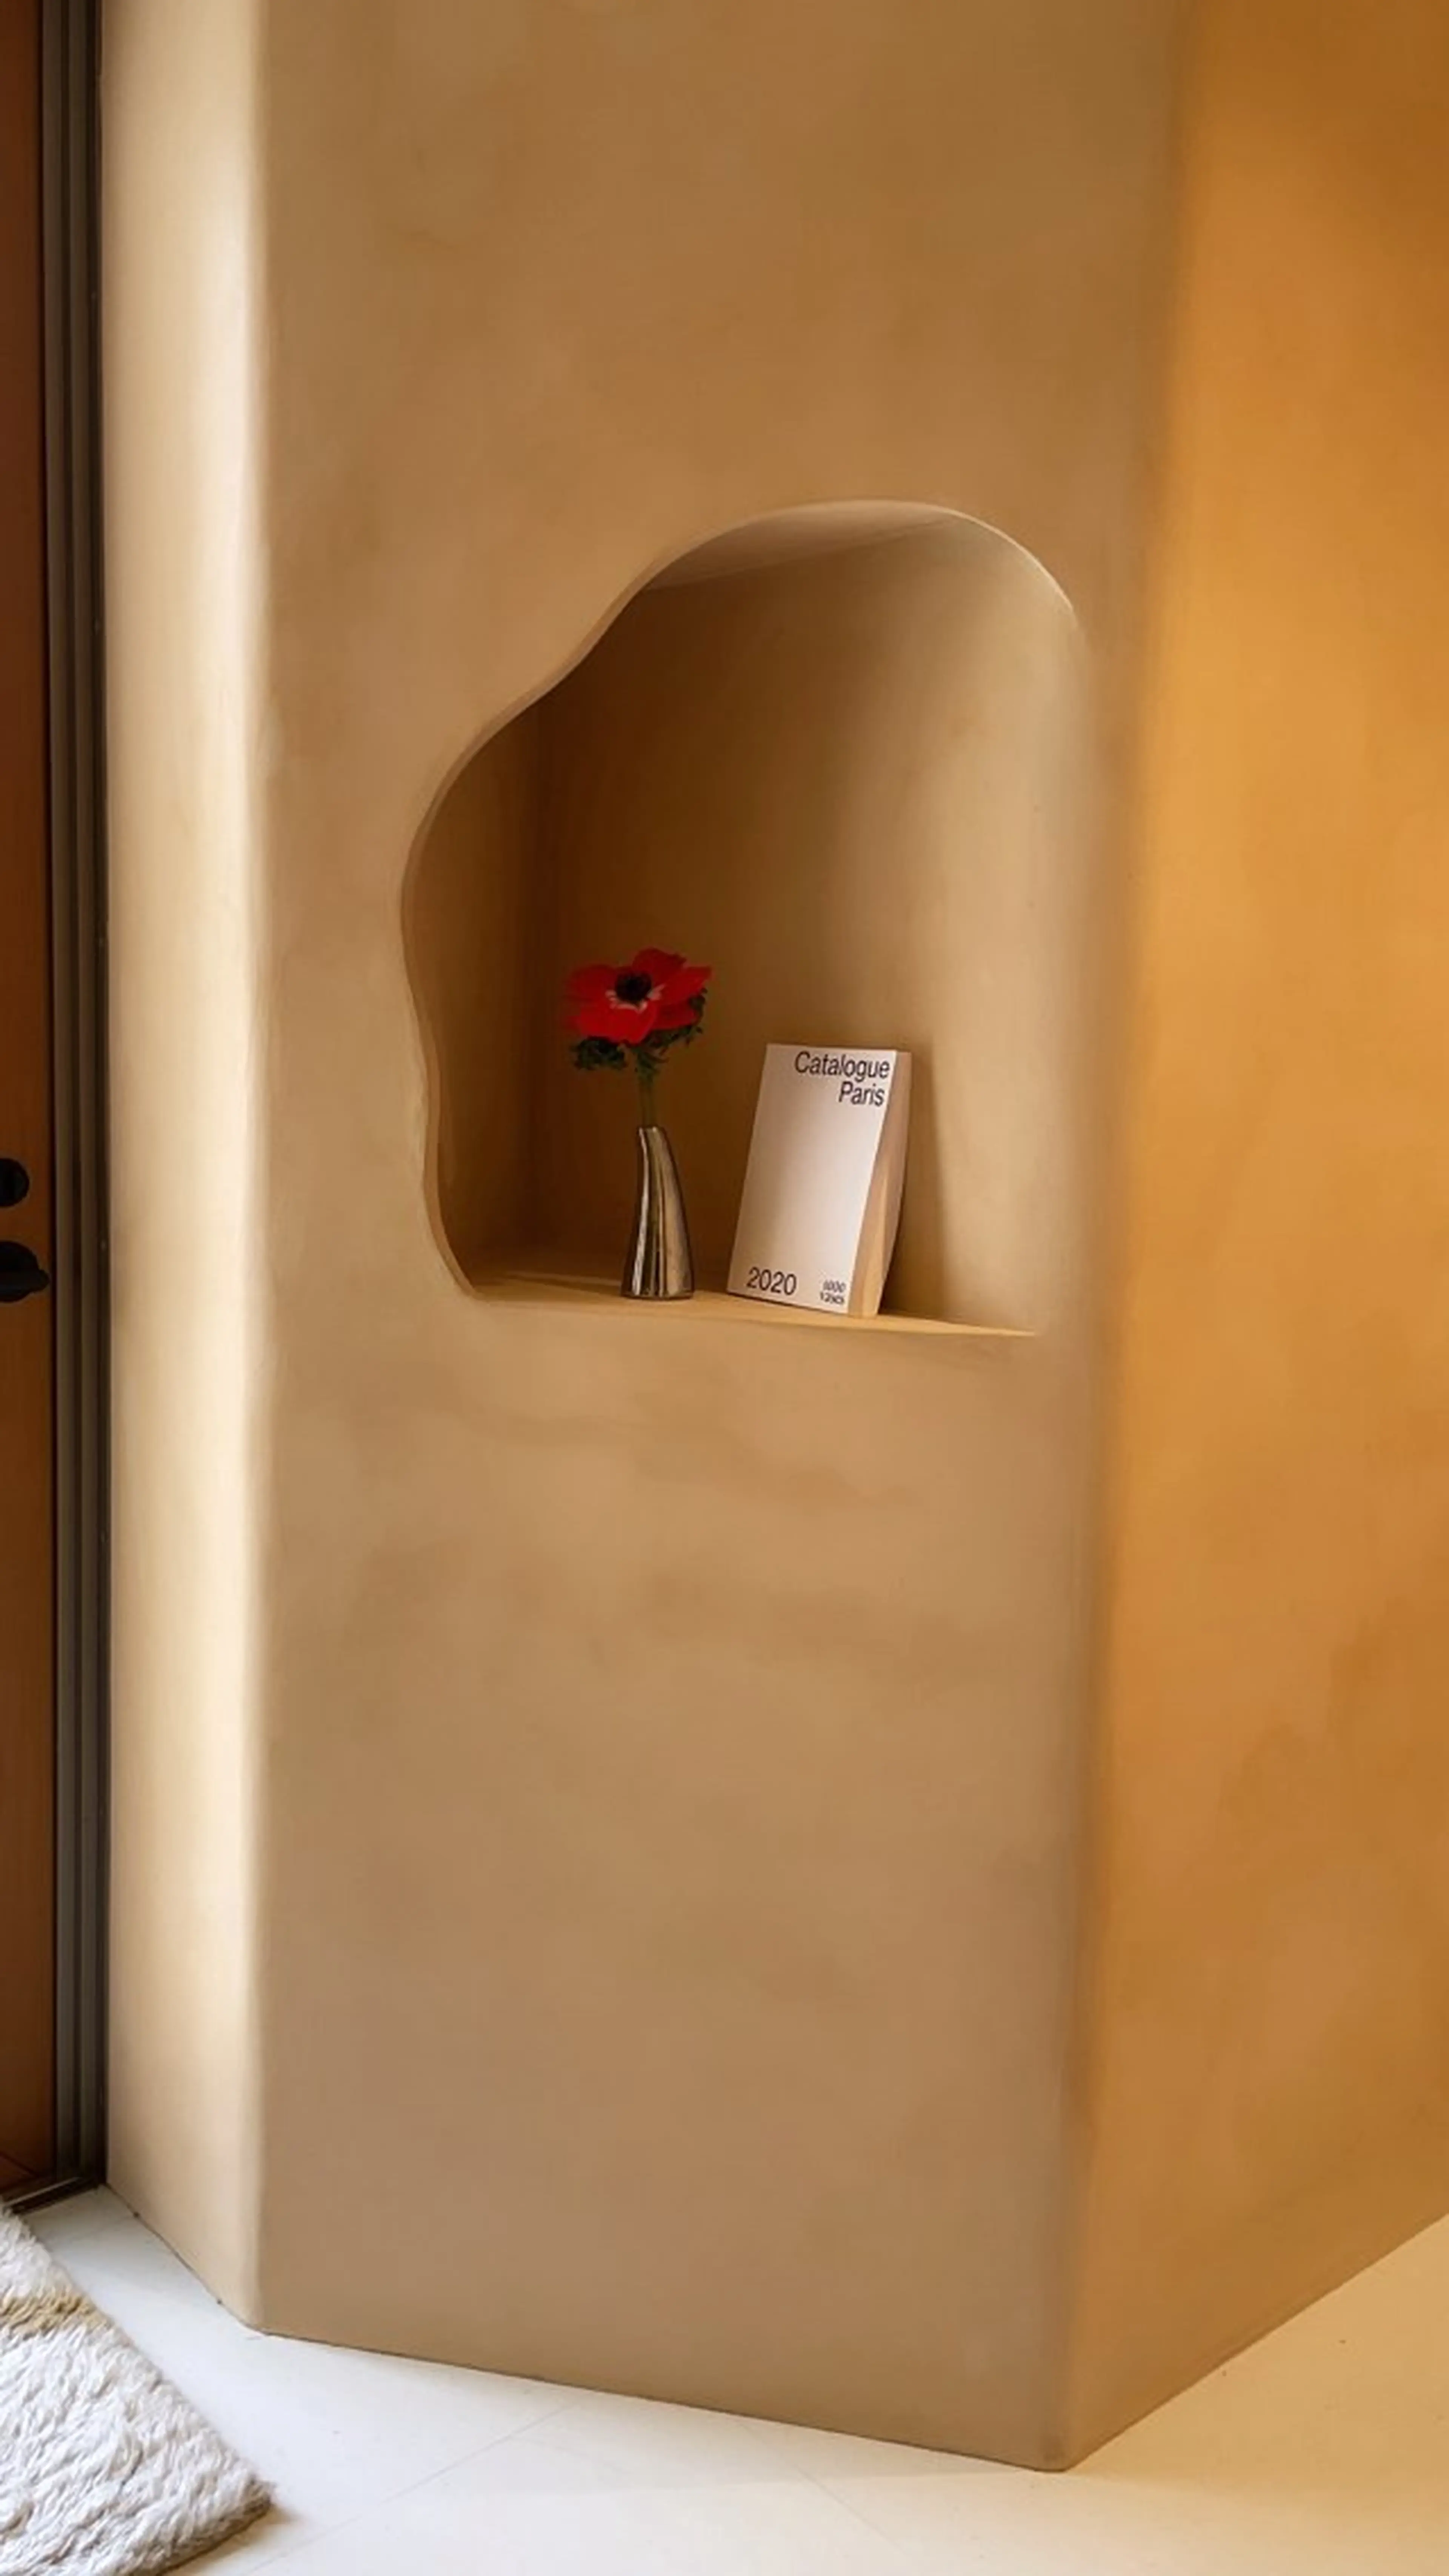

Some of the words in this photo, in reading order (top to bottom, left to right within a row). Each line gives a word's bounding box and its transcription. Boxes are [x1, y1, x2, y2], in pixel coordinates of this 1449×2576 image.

[794, 1050, 890, 1082] Catalogue
[838, 1081, 885, 1106] Paris
[747, 1267, 797, 1295] 2020
